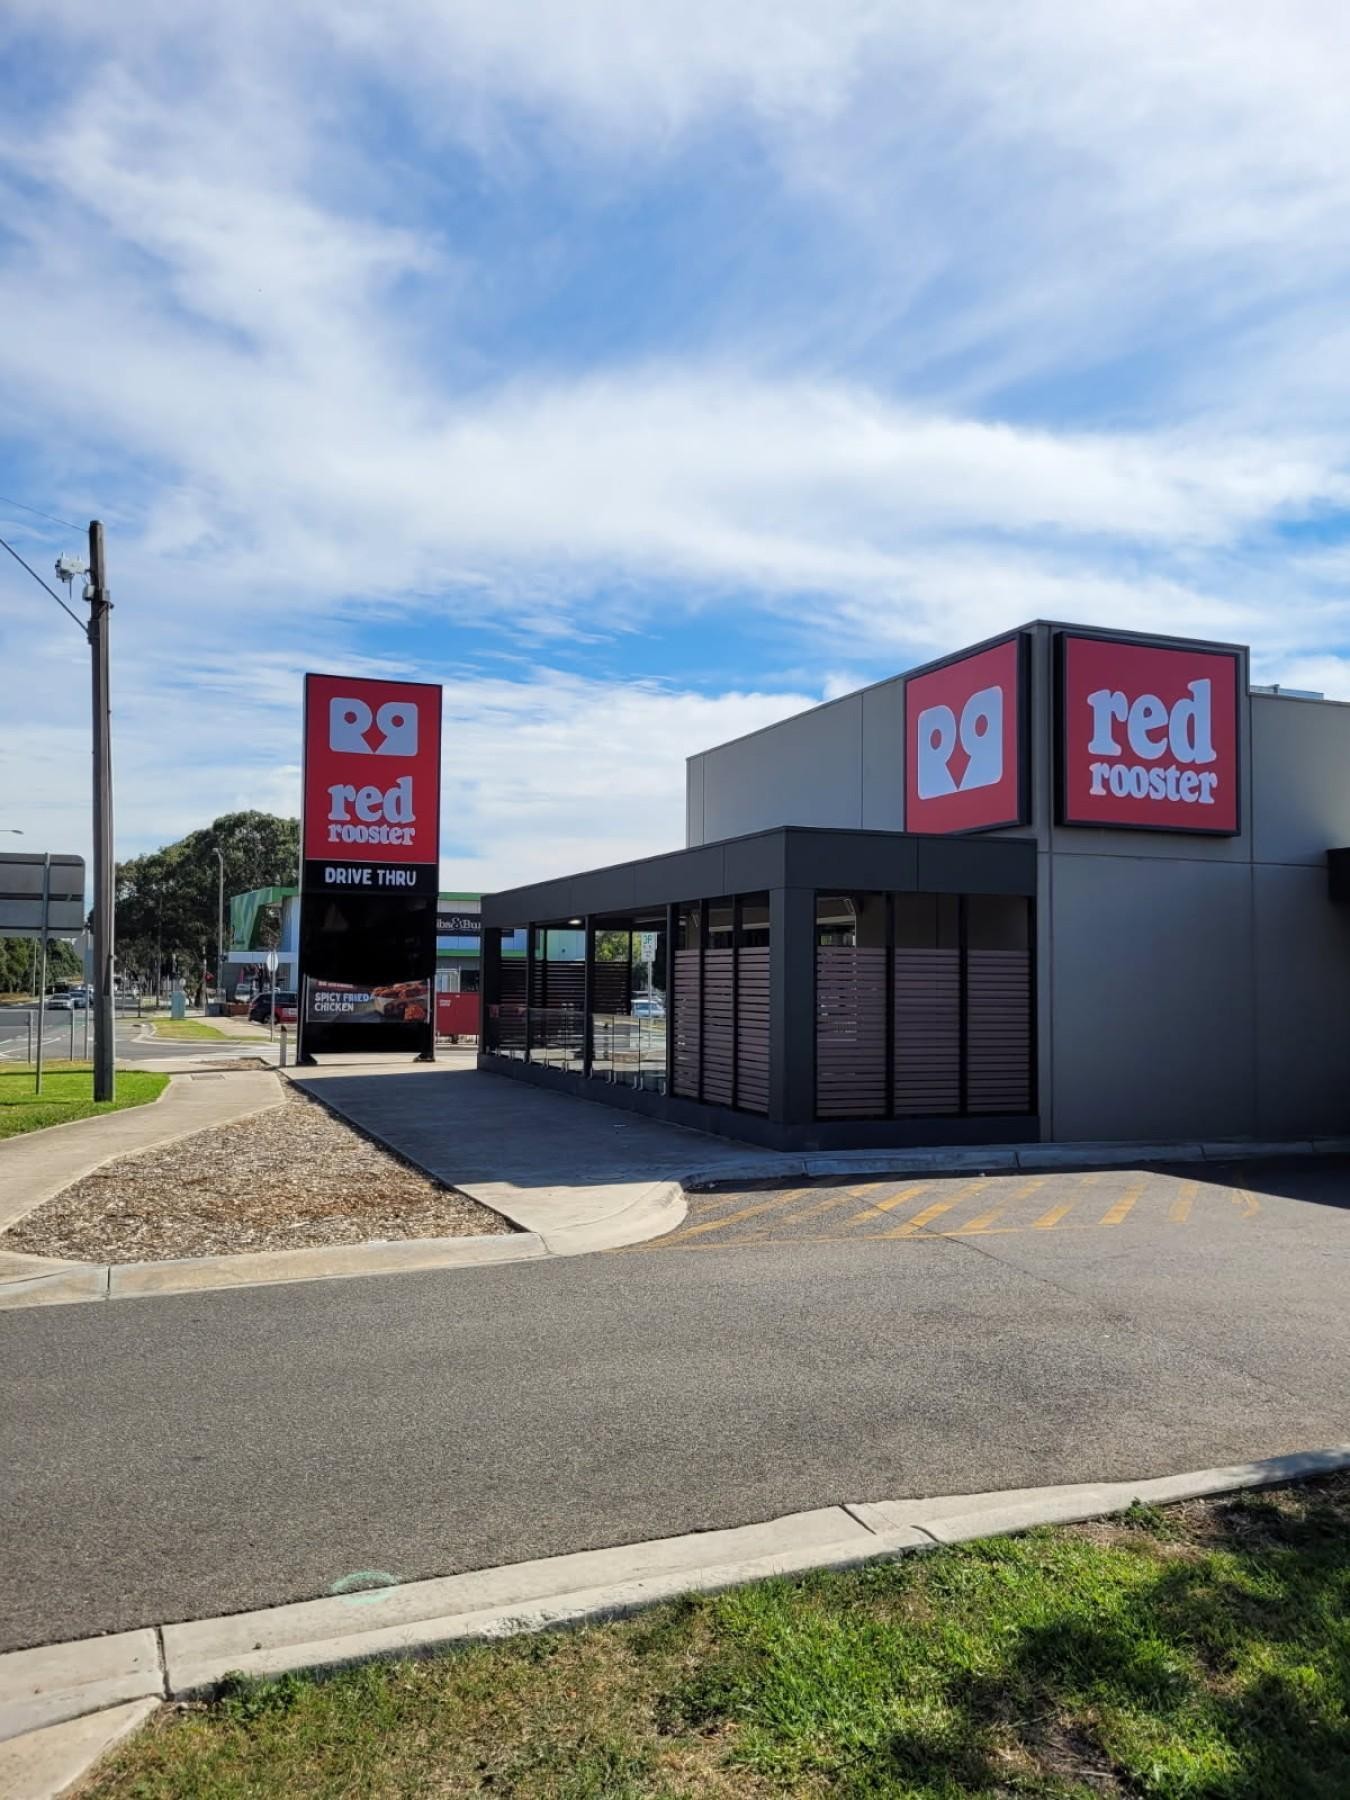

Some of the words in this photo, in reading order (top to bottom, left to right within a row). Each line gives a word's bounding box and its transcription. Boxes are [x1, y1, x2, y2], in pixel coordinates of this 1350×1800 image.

[1087, 678, 1217, 764] red
[1089, 762, 1217, 804] rooster
[327, 776, 416, 823] red
[327, 824, 416, 846] rooster
[324, 867, 372, 885] DRIVE
[377, 869, 416, 886] THRU
[314, 992, 341, 1002] SPICY
[343, 993, 370, 1002] FRIED
[314, 1002, 354, 1012] CHICKEN
